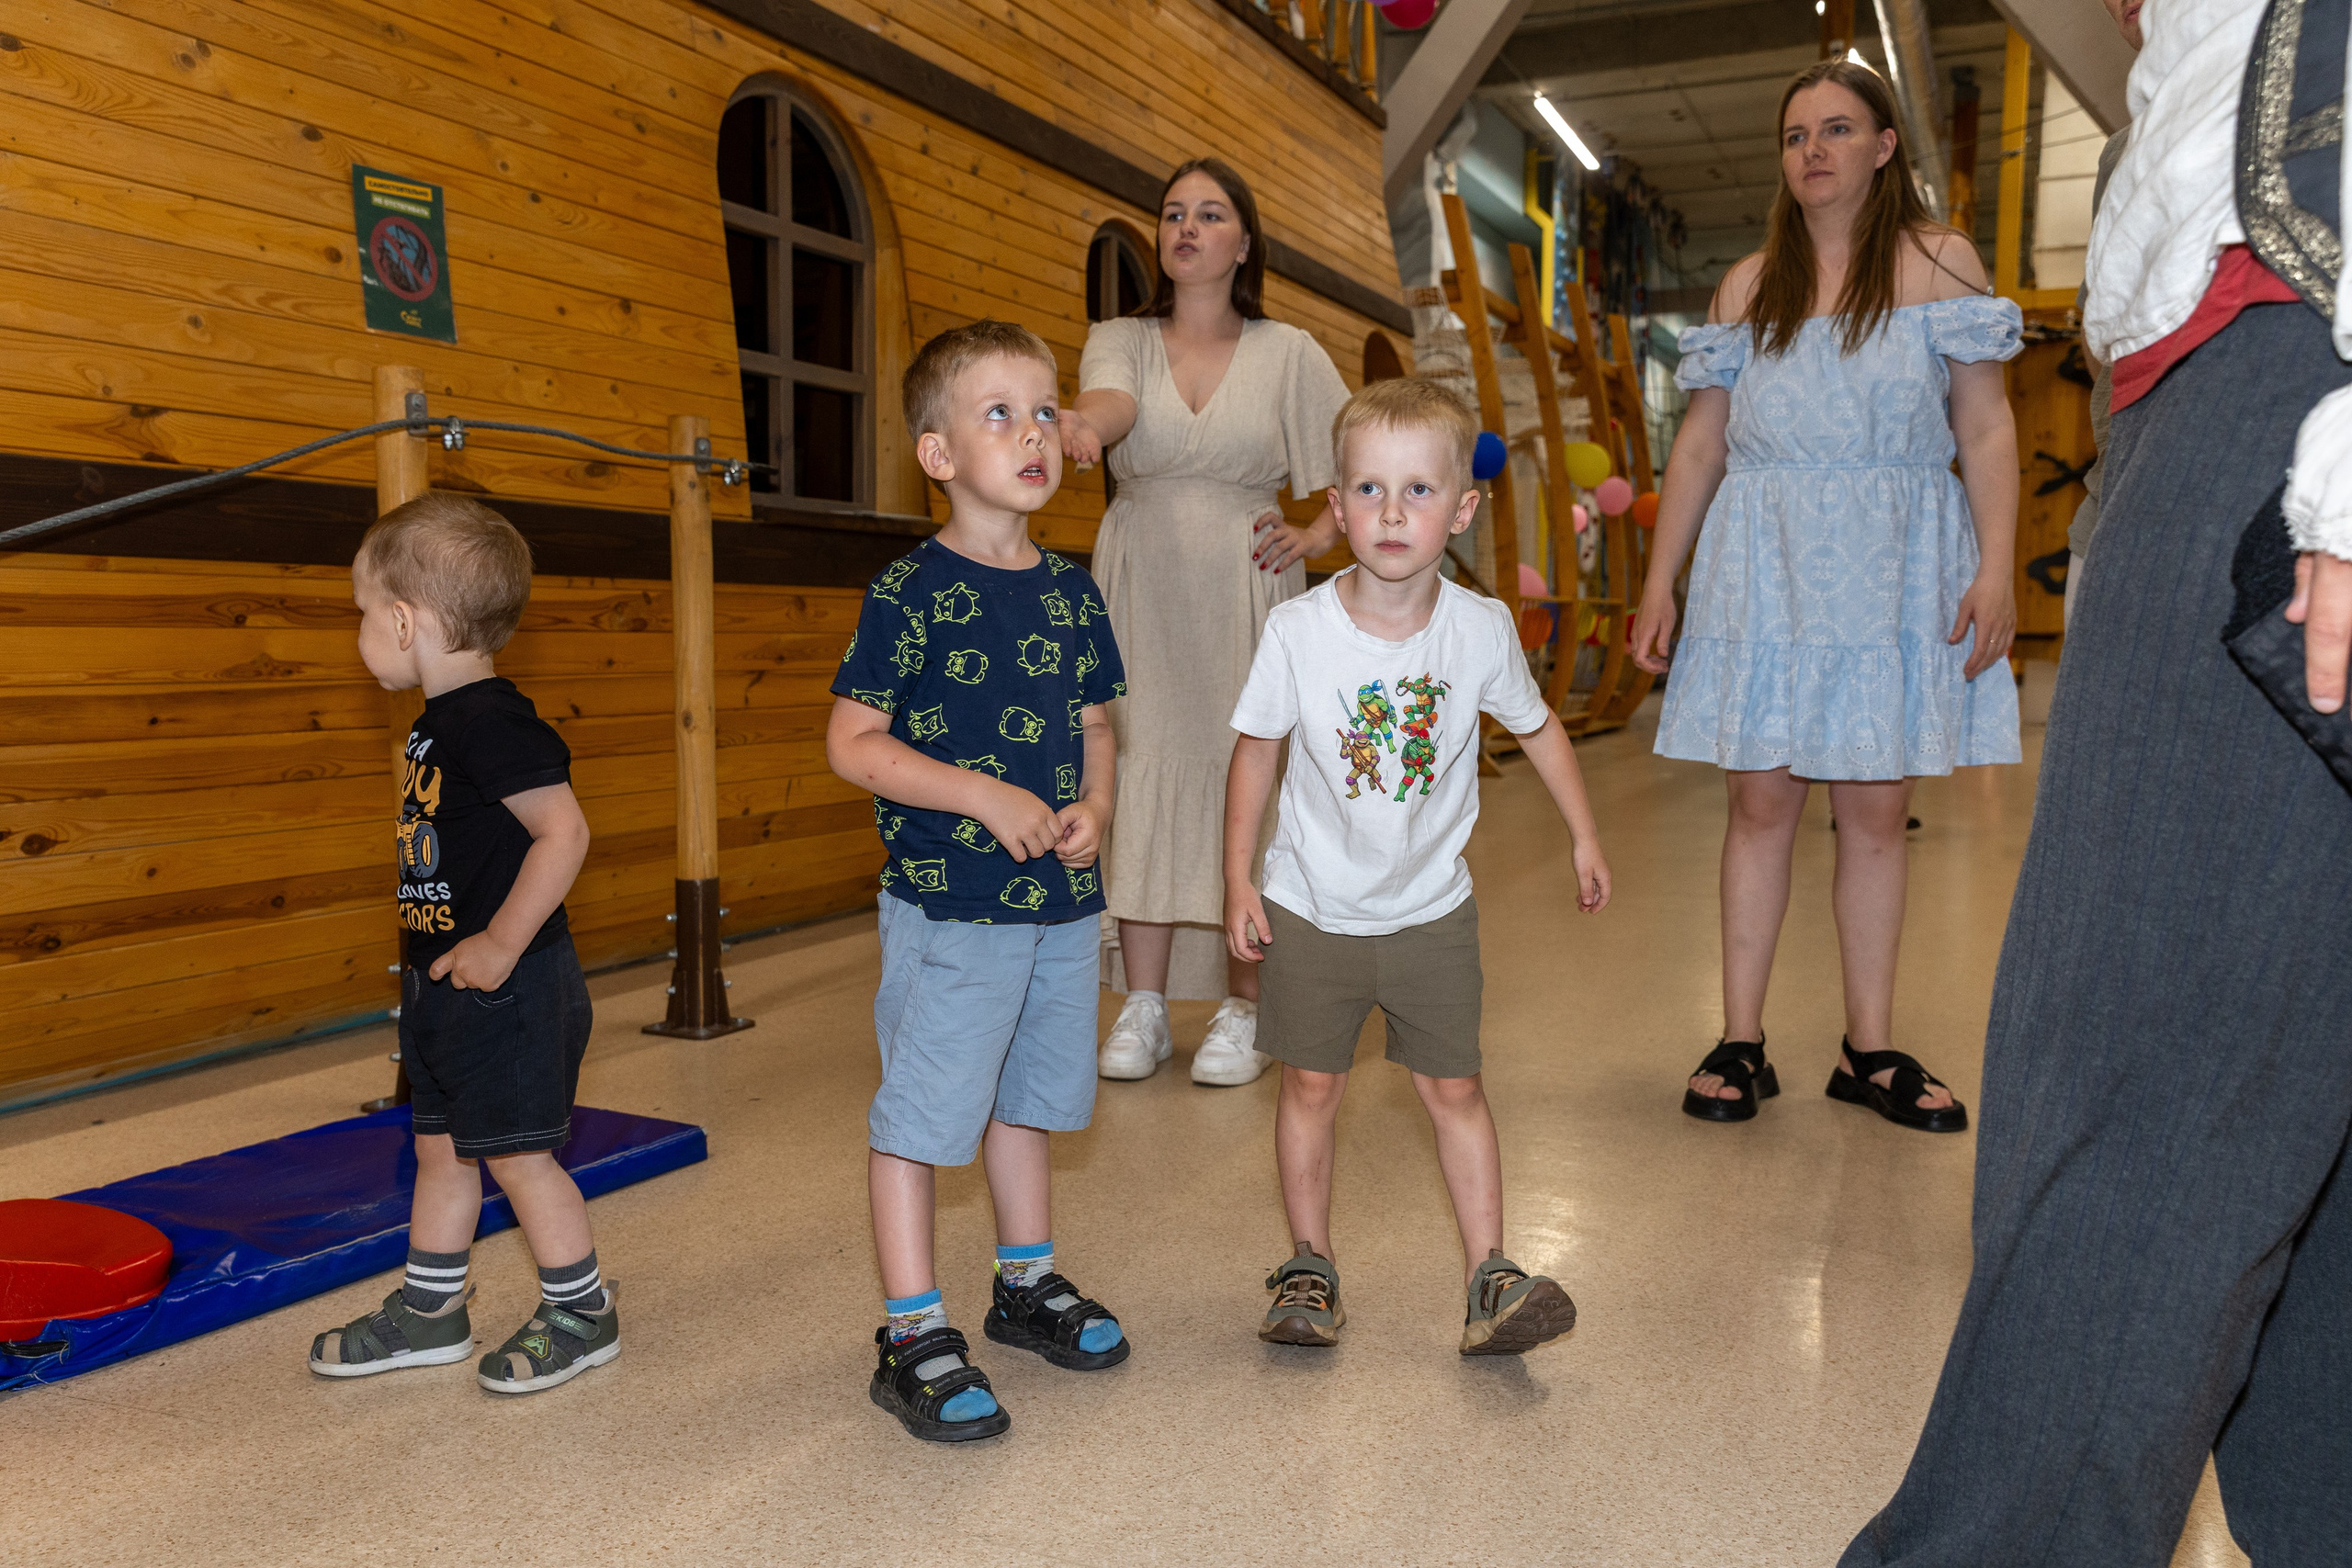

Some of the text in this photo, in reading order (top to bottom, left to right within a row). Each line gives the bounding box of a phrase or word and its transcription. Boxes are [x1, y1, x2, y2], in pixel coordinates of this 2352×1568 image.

[397, 881, 452, 901] LOVES
[556, 1314, 576, 1327] KIDS
[912, 1339, 932, 1351] EVERYDAY
